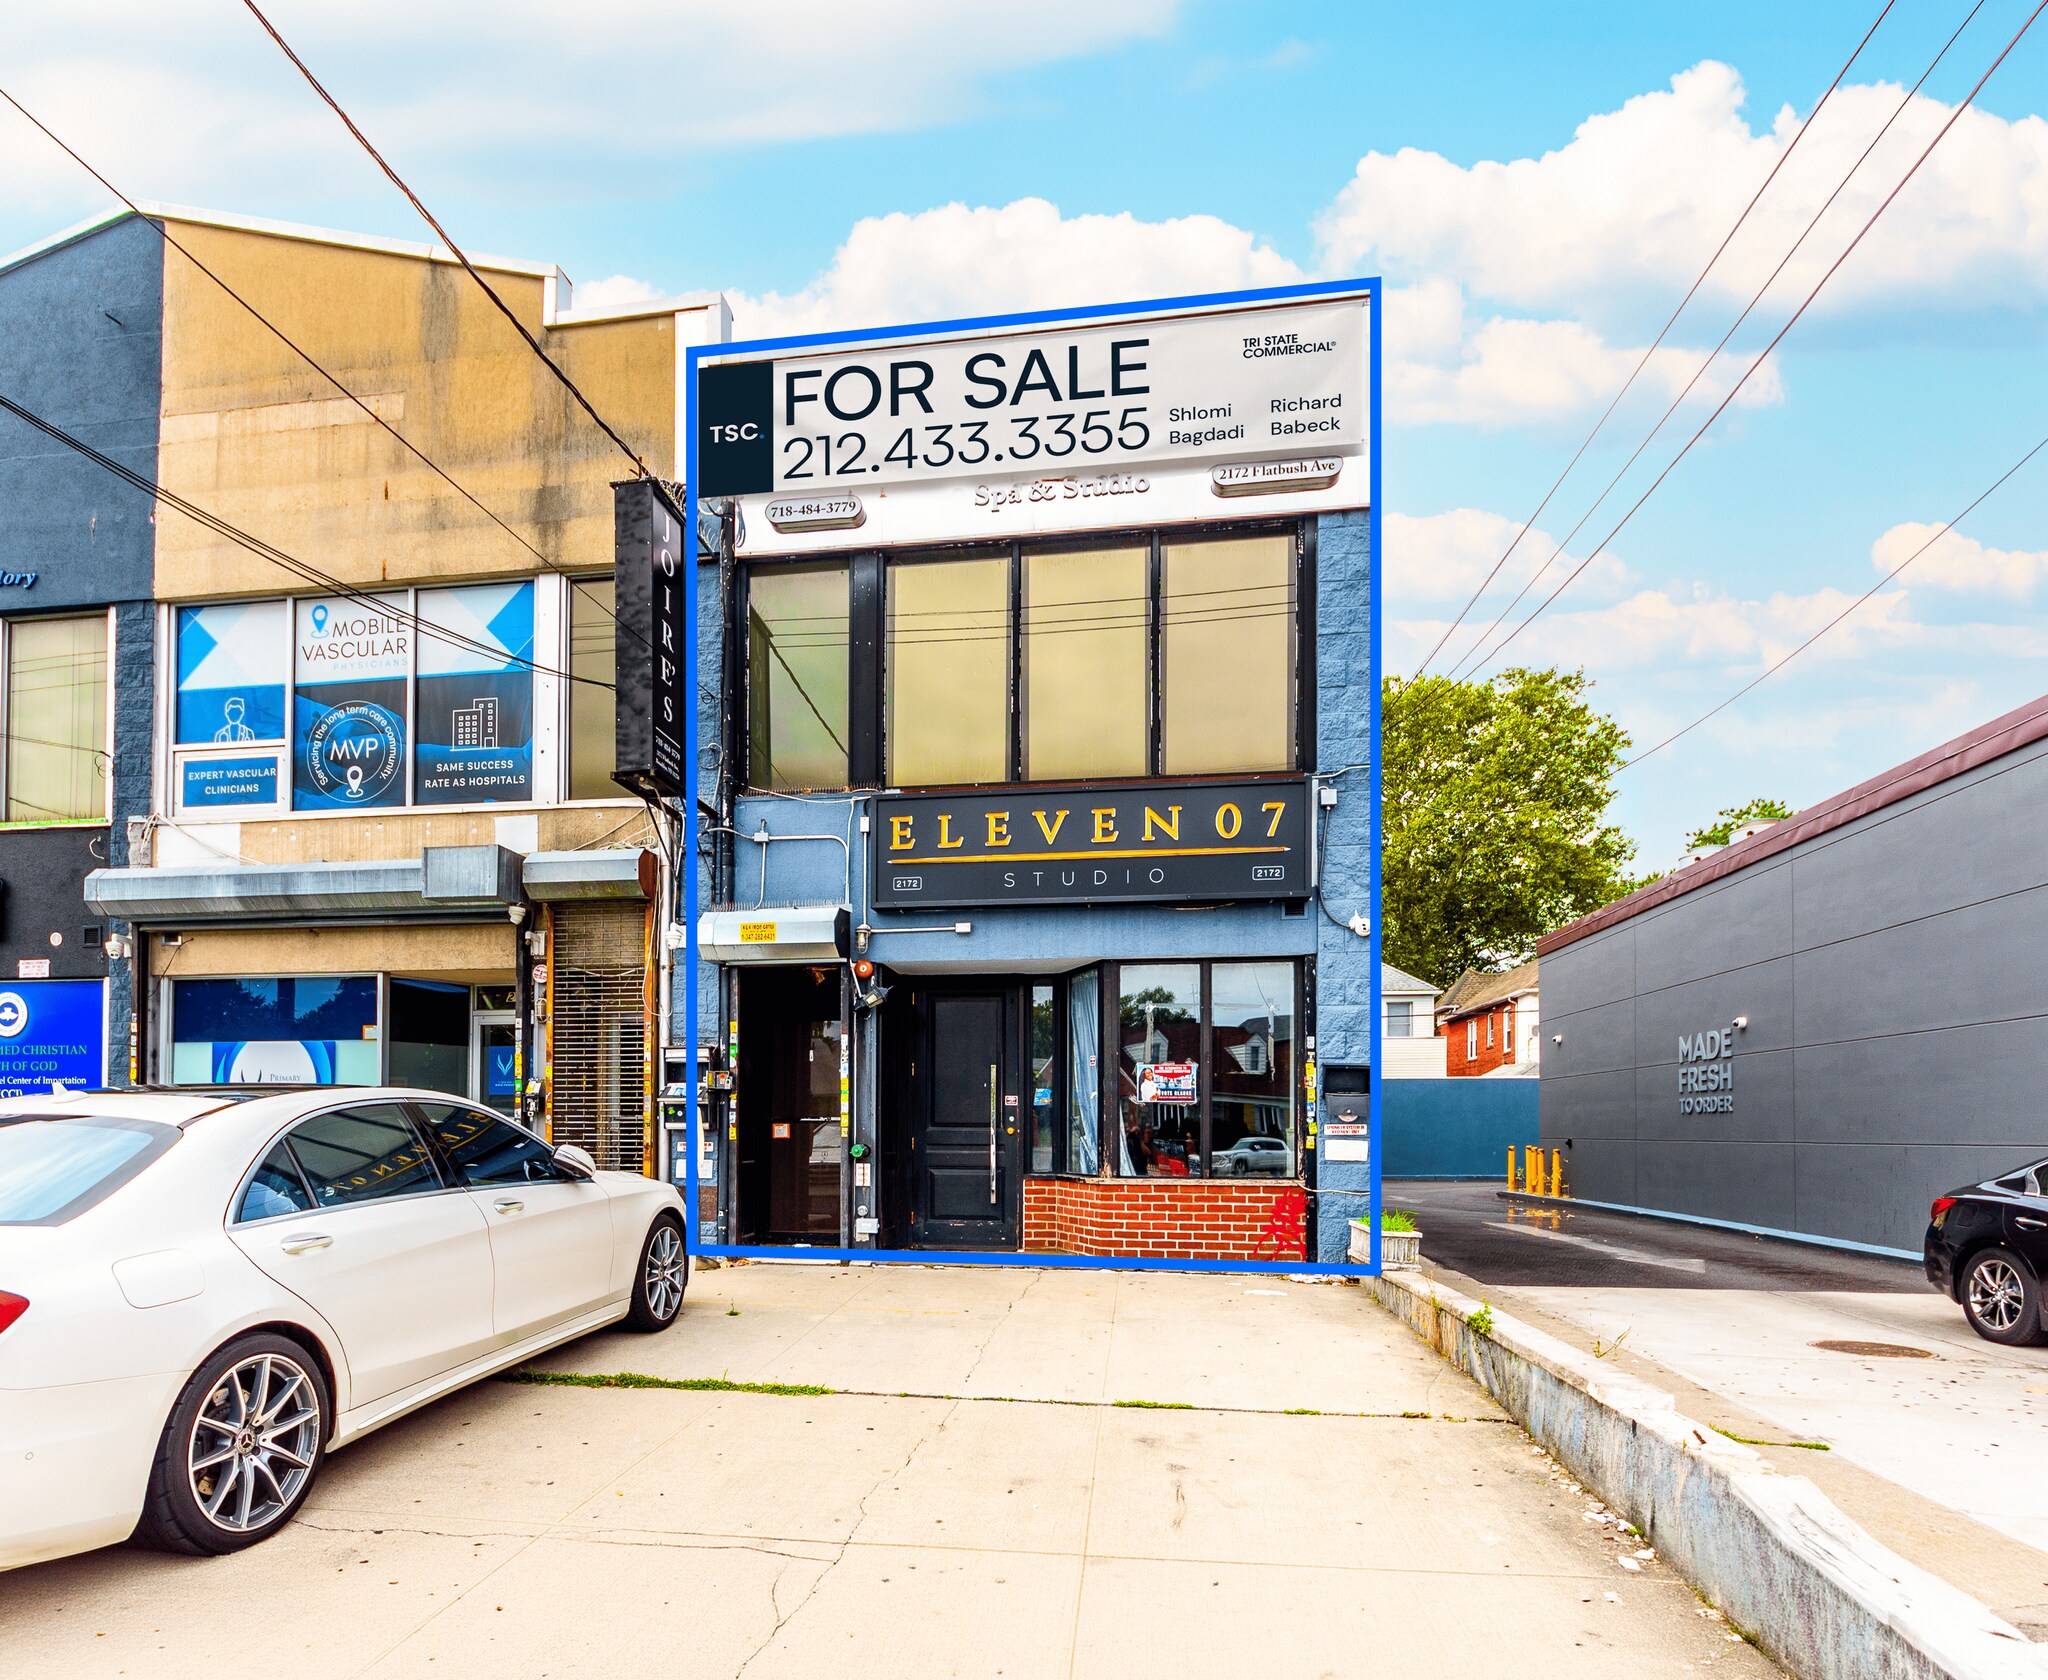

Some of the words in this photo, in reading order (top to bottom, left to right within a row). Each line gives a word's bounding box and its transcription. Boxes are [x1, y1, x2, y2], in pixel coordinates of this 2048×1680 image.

[1243, 337, 1260, 348] TRI
[1264, 333, 1298, 346] STATE
[786, 360, 935, 426] FOR
[964, 338, 1150, 409] SALE
[1169, 403, 1232, 422] Shlomi
[1270, 394, 1342, 413] Richard
[709, 423, 765, 444] TSC.
[1169, 425, 1244, 446] Bagdadi
[1271, 417, 1341, 436] Babeck
[783, 407, 1150, 480] 212.433.3355
[1219, 465, 1250, 481] 2172
[1252, 461, 1308, 478] Flatbush
[1310, 459, 1336, 473] Ave
[975, 484, 1022, 513] Spa
[1063, 473, 1151, 498] Studio
[771, 501, 857, 517] 718-484-3779
[332, 616, 408, 638] MOBILE
[302, 638, 408, 661] VASCULAR
[333, 658, 408, 671] PHYSICIANS
[325, 709, 345, 725] long
[346, 706, 368, 716] term
[369, 710, 388, 727] care
[315, 724, 328, 739] the
[330, 737, 378, 760] MVP
[311, 740, 328, 786] Servicing
[436, 762, 465, 773] SAME
[466, 760, 514, 771] SUCCESS
[188, 769, 224, 781] EXPERT
[227, 767, 277, 779] VASCULAR
[424, 778, 450, 789] RATE
[452, 777, 466, 788] AS
[468, 774, 526, 787] HOSPITALS
[204, 783, 260, 795] CLINICIANS
[889, 805, 1183, 850] ELEVEN
[1215, 802, 1287, 839] 07
[1004, 868, 1165, 888] STUDIO
[1256, 867, 1281, 879] 2172
[896, 878, 919, 889] 2172
[22, 1045, 87, 1055] CHRISTIAN
[1679, 1027, 1732, 1064] MADE
[12, 1061, 28, 1071] OF
[30, 1061, 58, 1071] GOD
[7, 1076, 31, 1084] Center
[33, 1076, 41, 1084] of
[1679, 1063, 1733, 1093] FRESH
[1679, 1098, 1694, 1114] TO
[1694, 1095, 1733, 1113] ORDER
